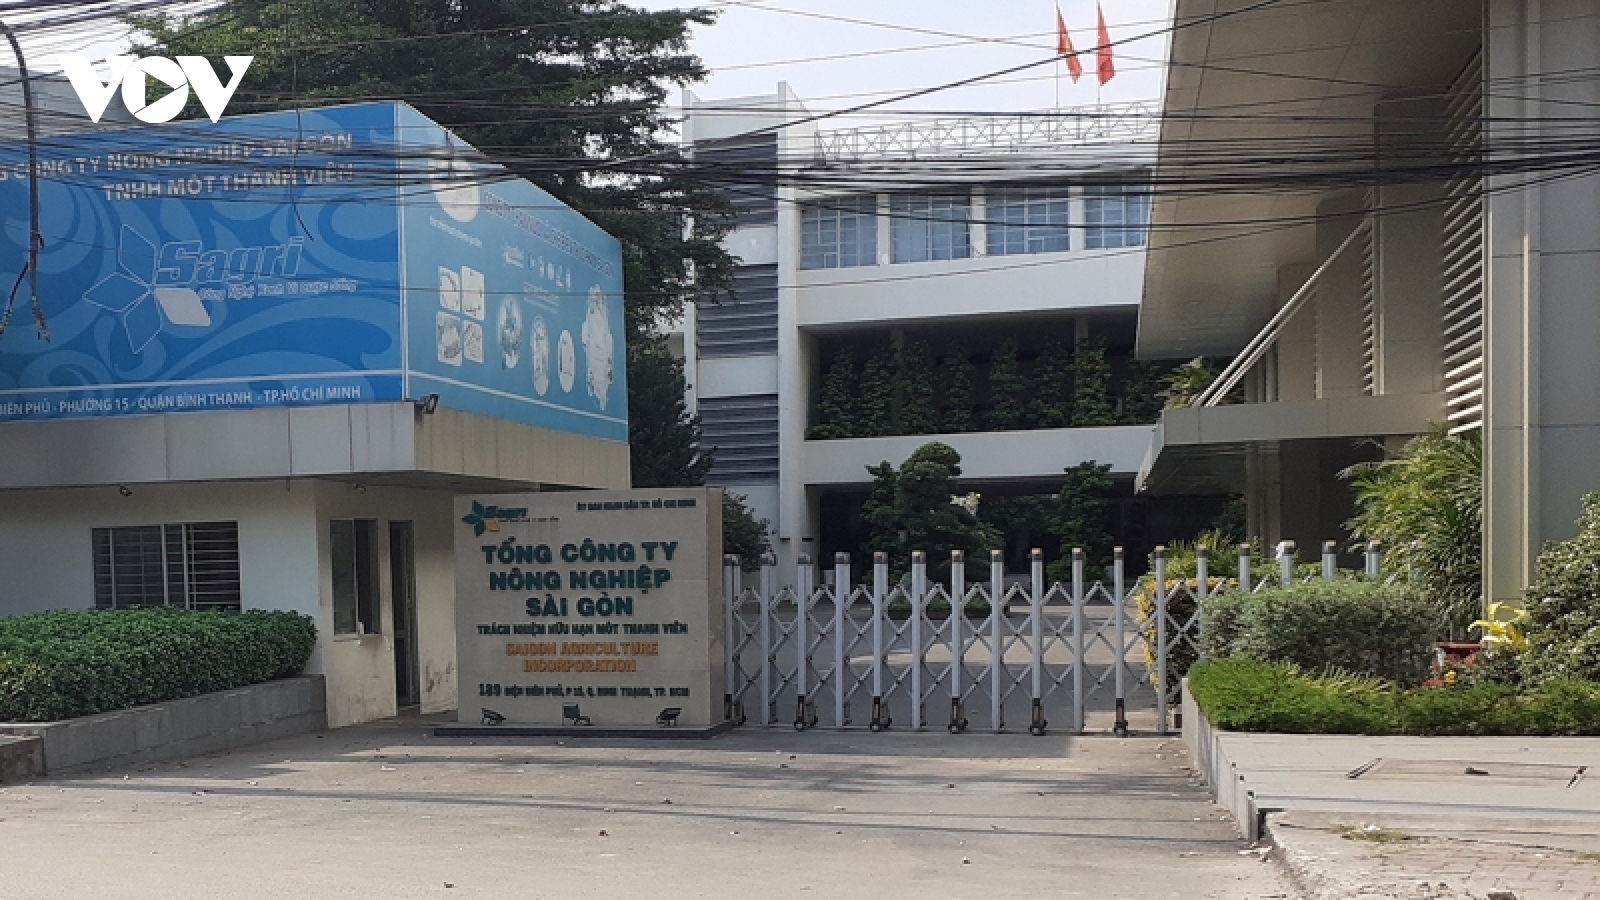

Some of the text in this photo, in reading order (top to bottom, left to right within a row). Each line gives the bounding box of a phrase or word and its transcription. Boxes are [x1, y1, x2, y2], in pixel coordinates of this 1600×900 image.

[76, 156, 101, 175] TY
[154, 236, 304, 285] Sagri
[116, 397, 129, 411] 15
[326, 385, 361, 399] MINH
[481, 536, 679, 564] TỔNG CÔNG TY
[489, 564, 671, 594] NÔNG NGHIỆP
[525, 591, 635, 617] SÀI GÒN
[505, 641, 659, 656] SAIGON AGRICULTURE
[523, 659, 636, 672] INCORPORATION
